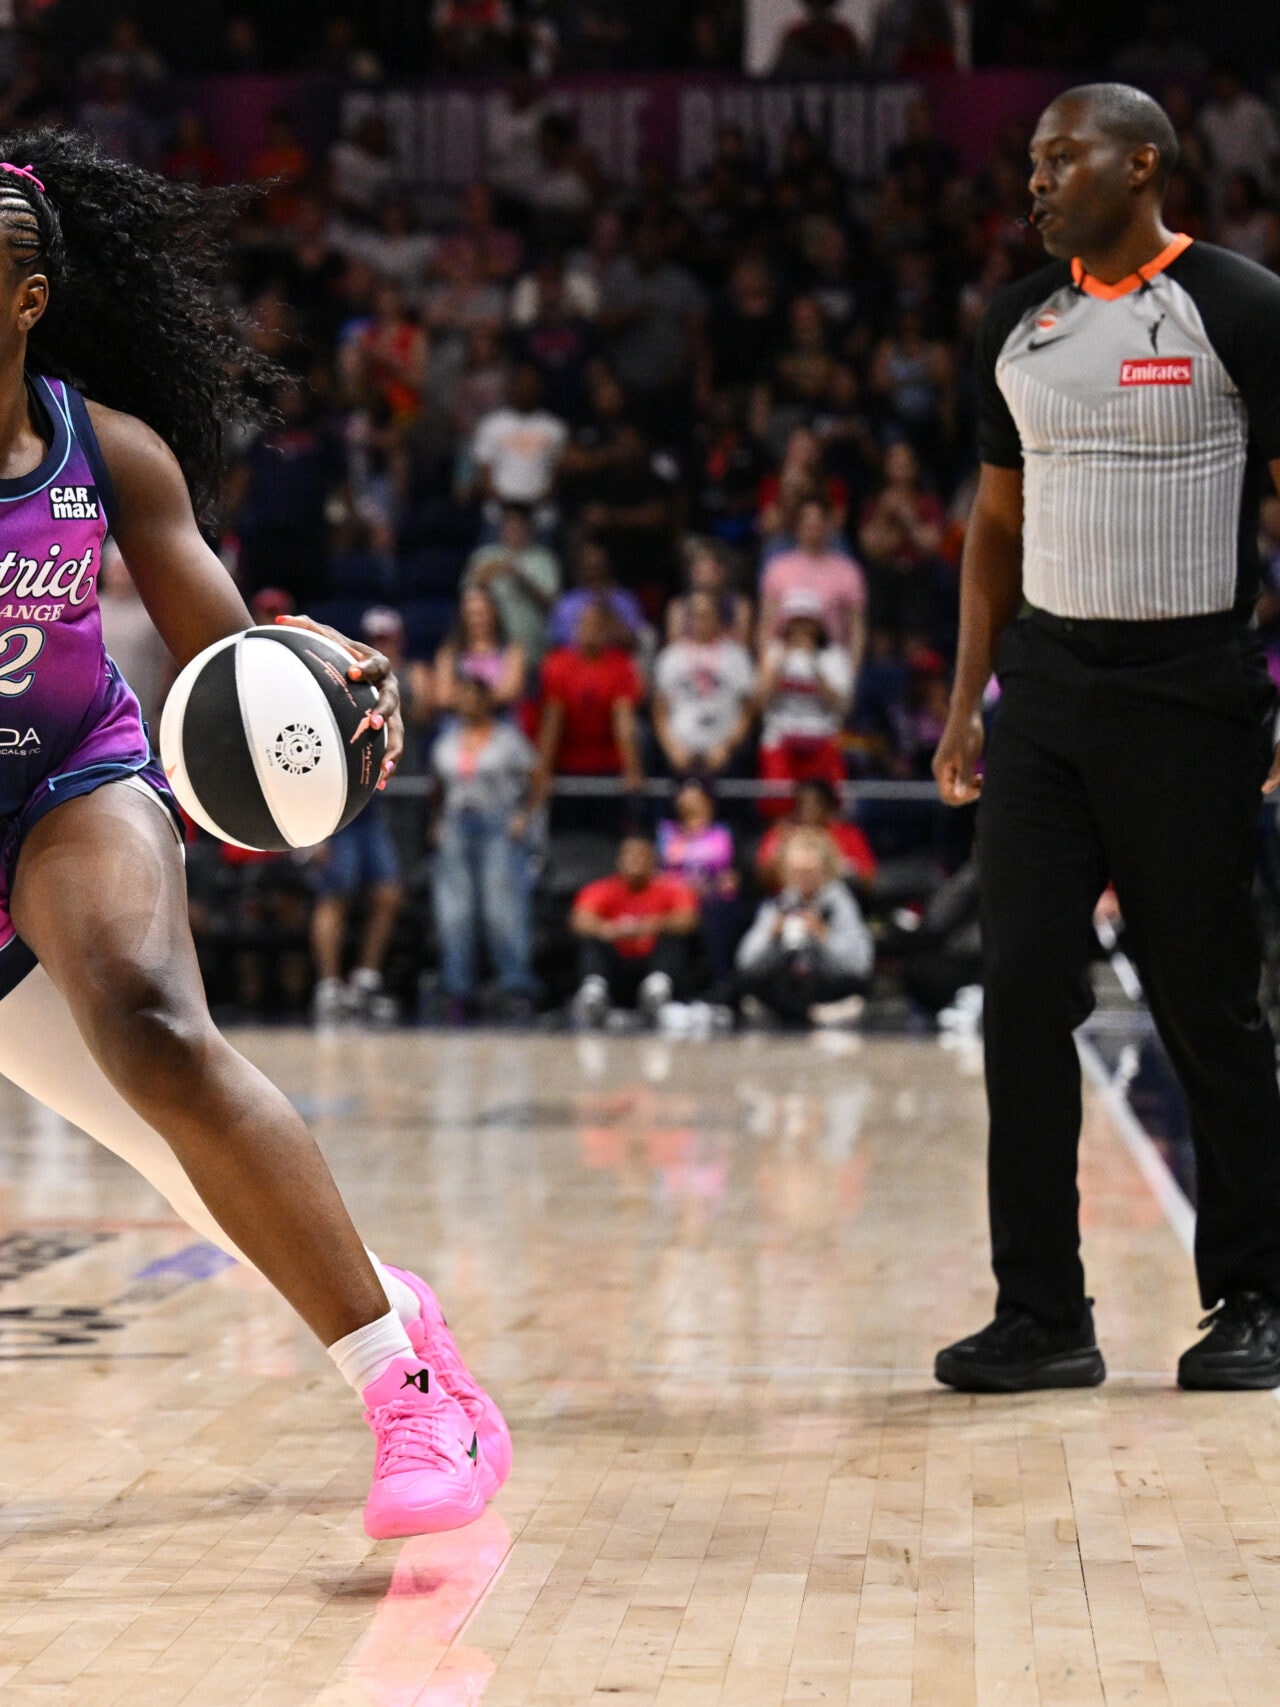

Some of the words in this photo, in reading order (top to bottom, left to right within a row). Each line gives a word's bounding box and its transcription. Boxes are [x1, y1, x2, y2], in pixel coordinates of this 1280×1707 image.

[1121, 363, 1190, 381] Emirates
[50, 487, 88, 503] CAR
[52, 503, 98, 518] max
